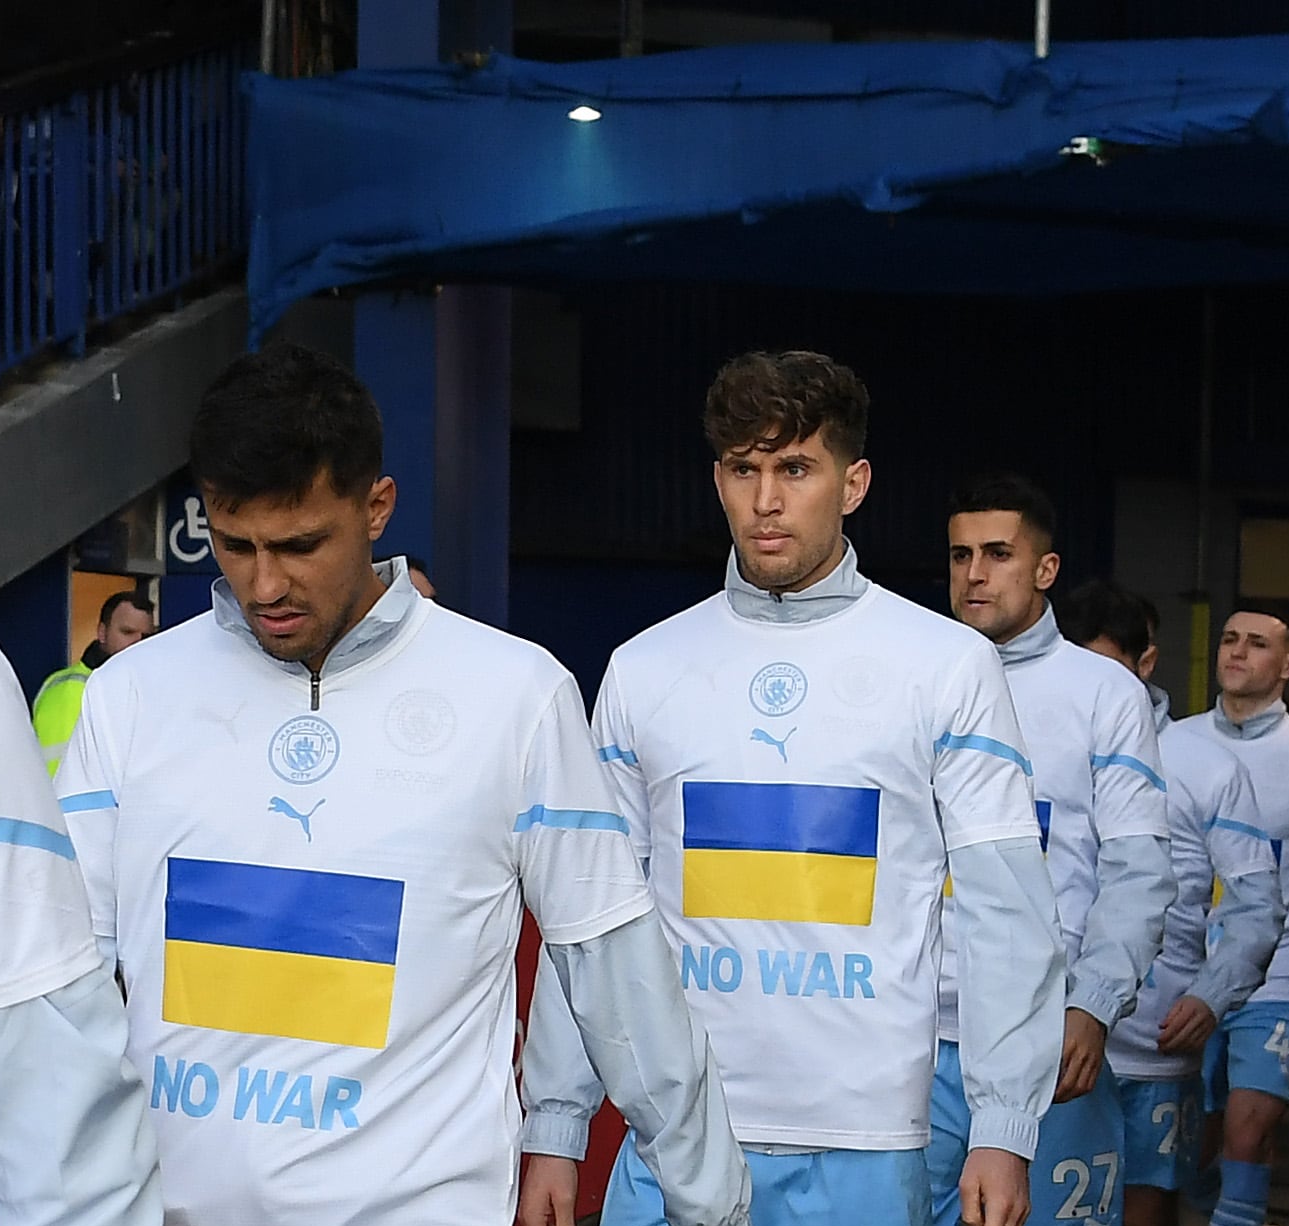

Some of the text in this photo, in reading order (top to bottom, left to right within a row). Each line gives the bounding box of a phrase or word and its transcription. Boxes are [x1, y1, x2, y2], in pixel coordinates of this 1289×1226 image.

[278, 721, 334, 743] MANCHESTER
[290, 771, 313, 779] CITY
[682, 945, 876, 1000] NO WAR
[150, 1055, 364, 1132] NO WAR
[1052, 1150, 1118, 1219] 27
